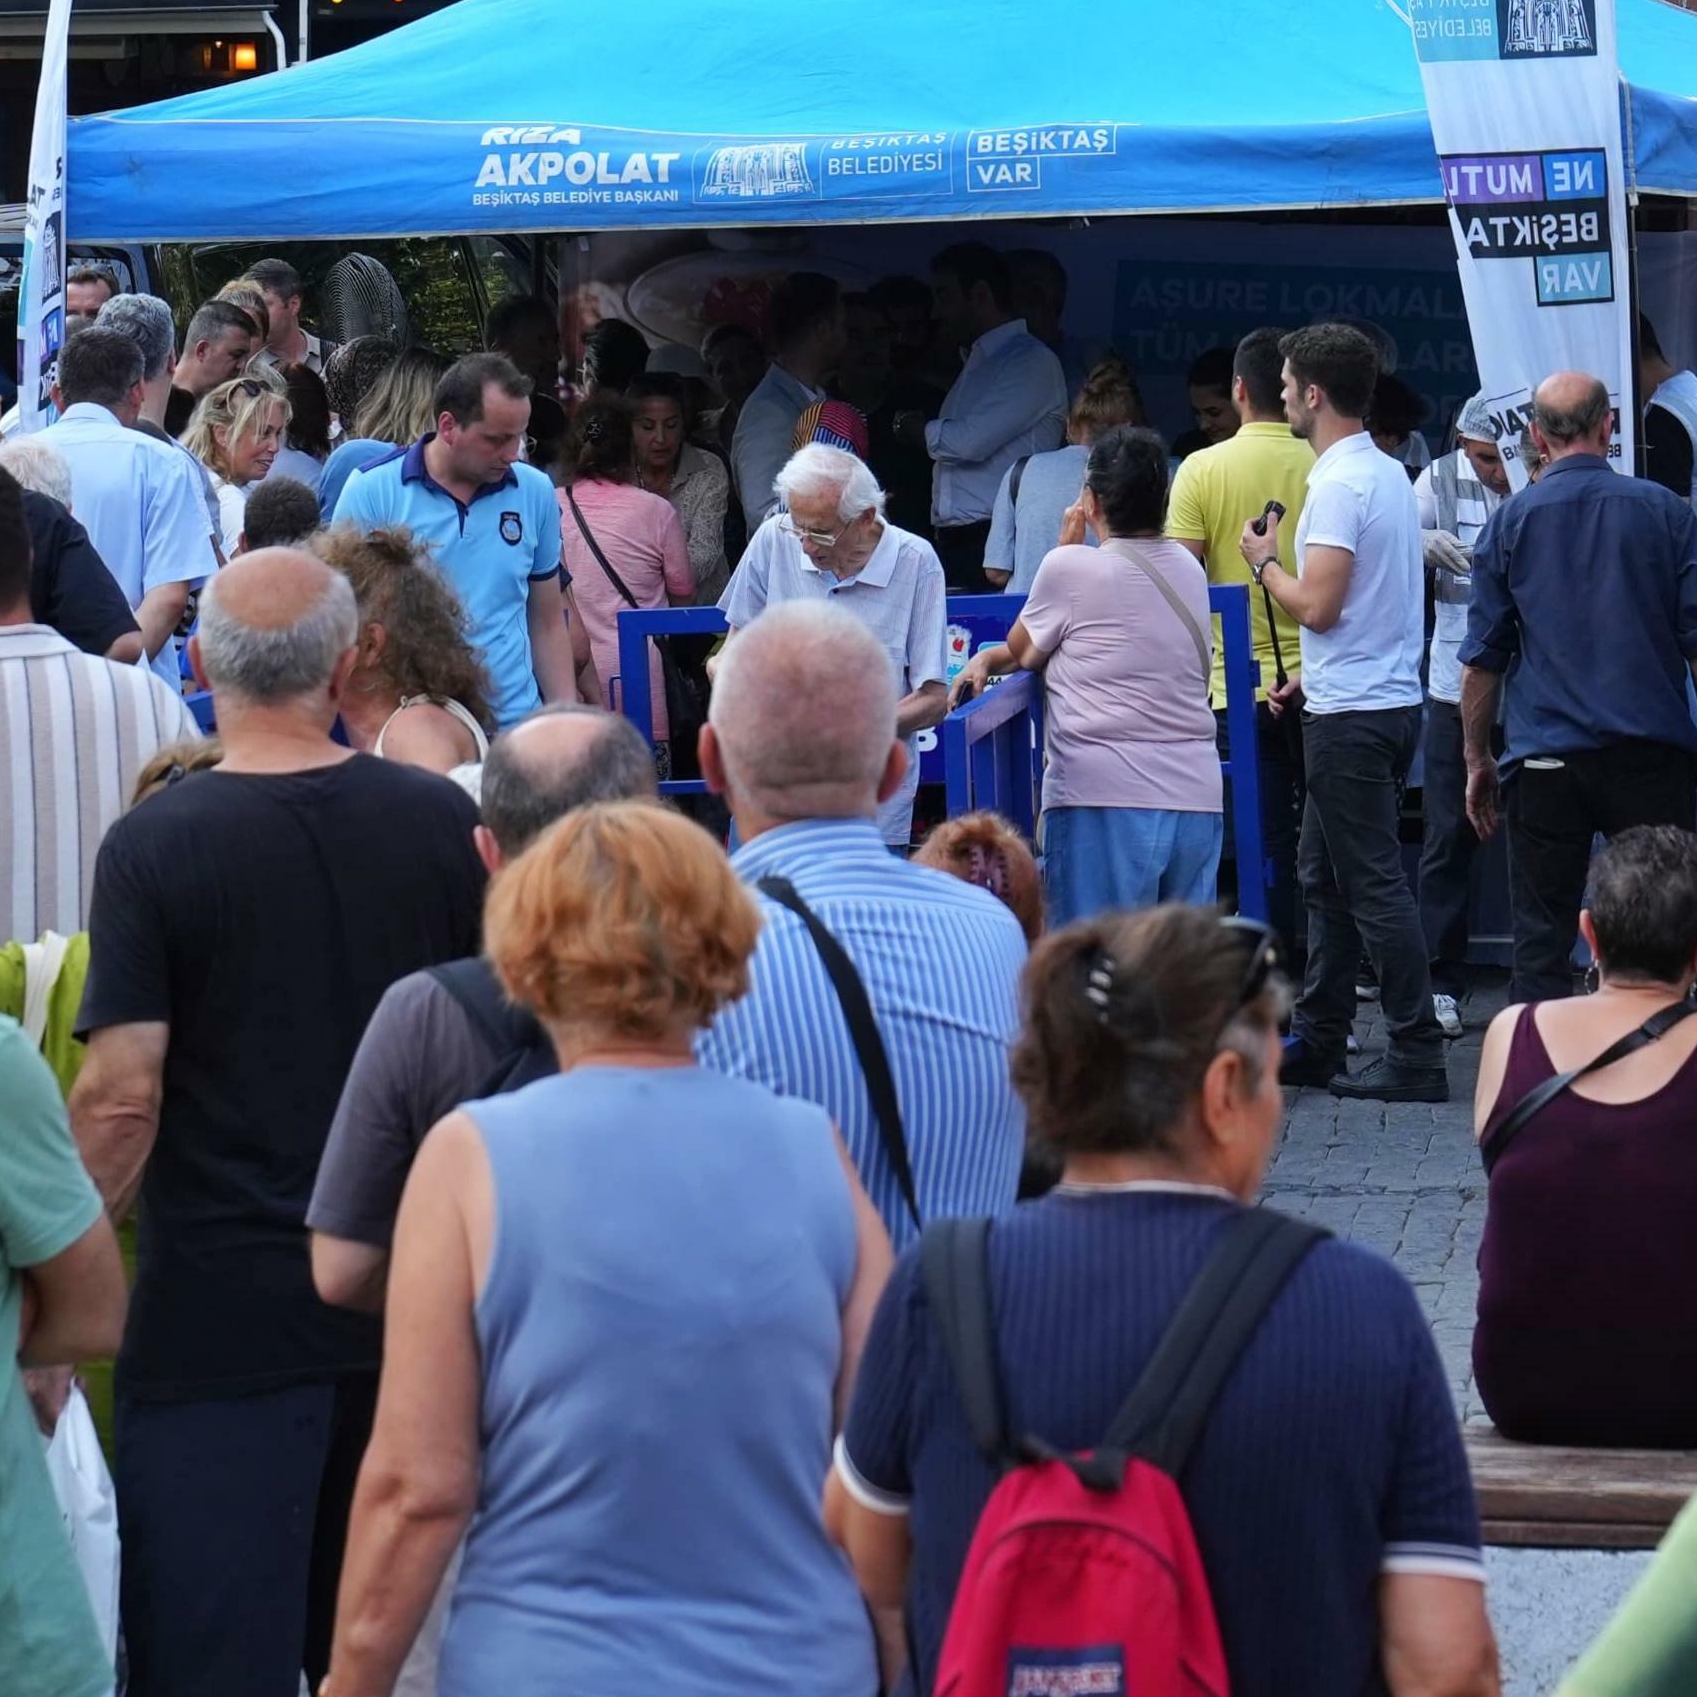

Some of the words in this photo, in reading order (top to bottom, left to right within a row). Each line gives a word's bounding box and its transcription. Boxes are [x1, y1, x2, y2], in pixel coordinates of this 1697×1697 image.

[474, 151, 681, 188] AKPOLAT
[828, 148, 943, 176] BELEDİYESİ
[977, 162, 1033, 185] VAR
[473, 189, 540, 208] BEŞİKTAŞ
[543, 187, 612, 205] BELEDİYE
[616, 190, 679, 207] BAŞKANI
[1279, 282, 1465, 319] LOKMAL
